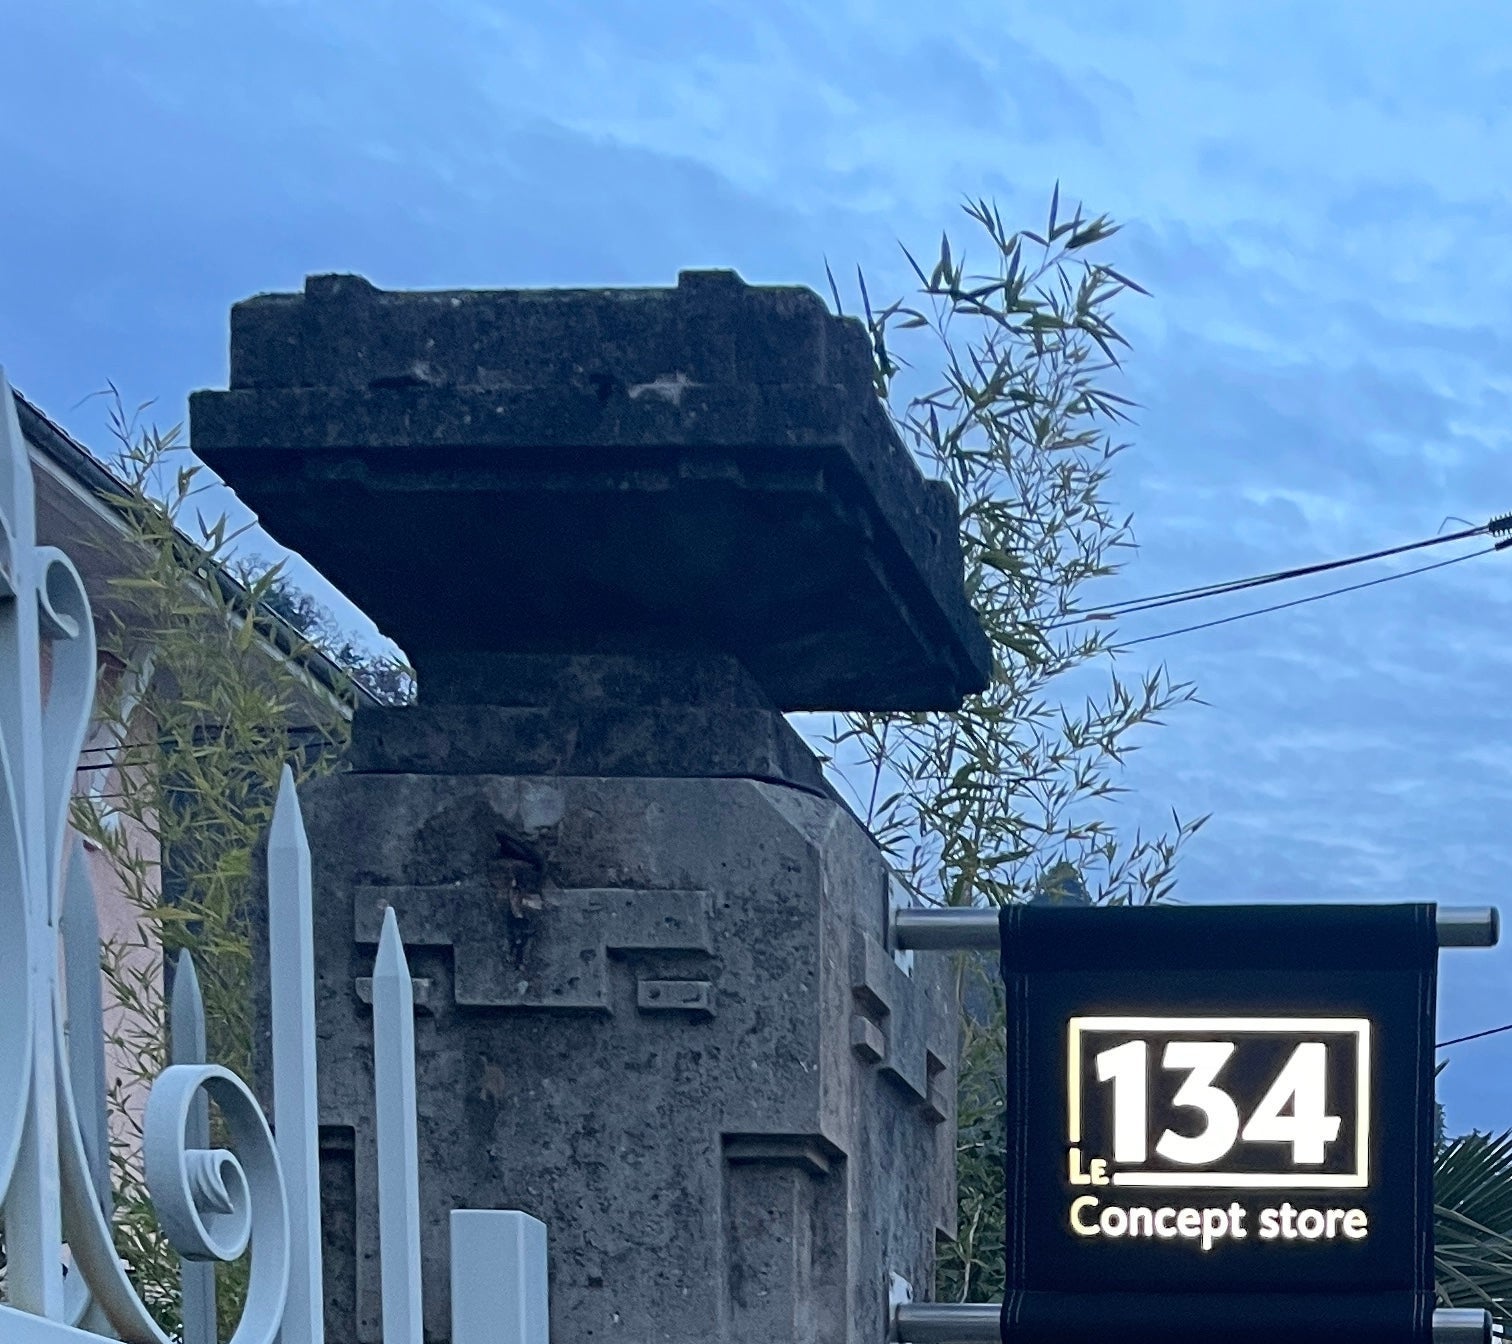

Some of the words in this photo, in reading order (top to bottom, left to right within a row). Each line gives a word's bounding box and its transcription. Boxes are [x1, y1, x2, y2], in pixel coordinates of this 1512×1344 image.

[1096, 1039, 1342, 1164] 134
[1070, 1195, 1248, 1251] Concept
[1258, 1202, 1368, 1239] store
